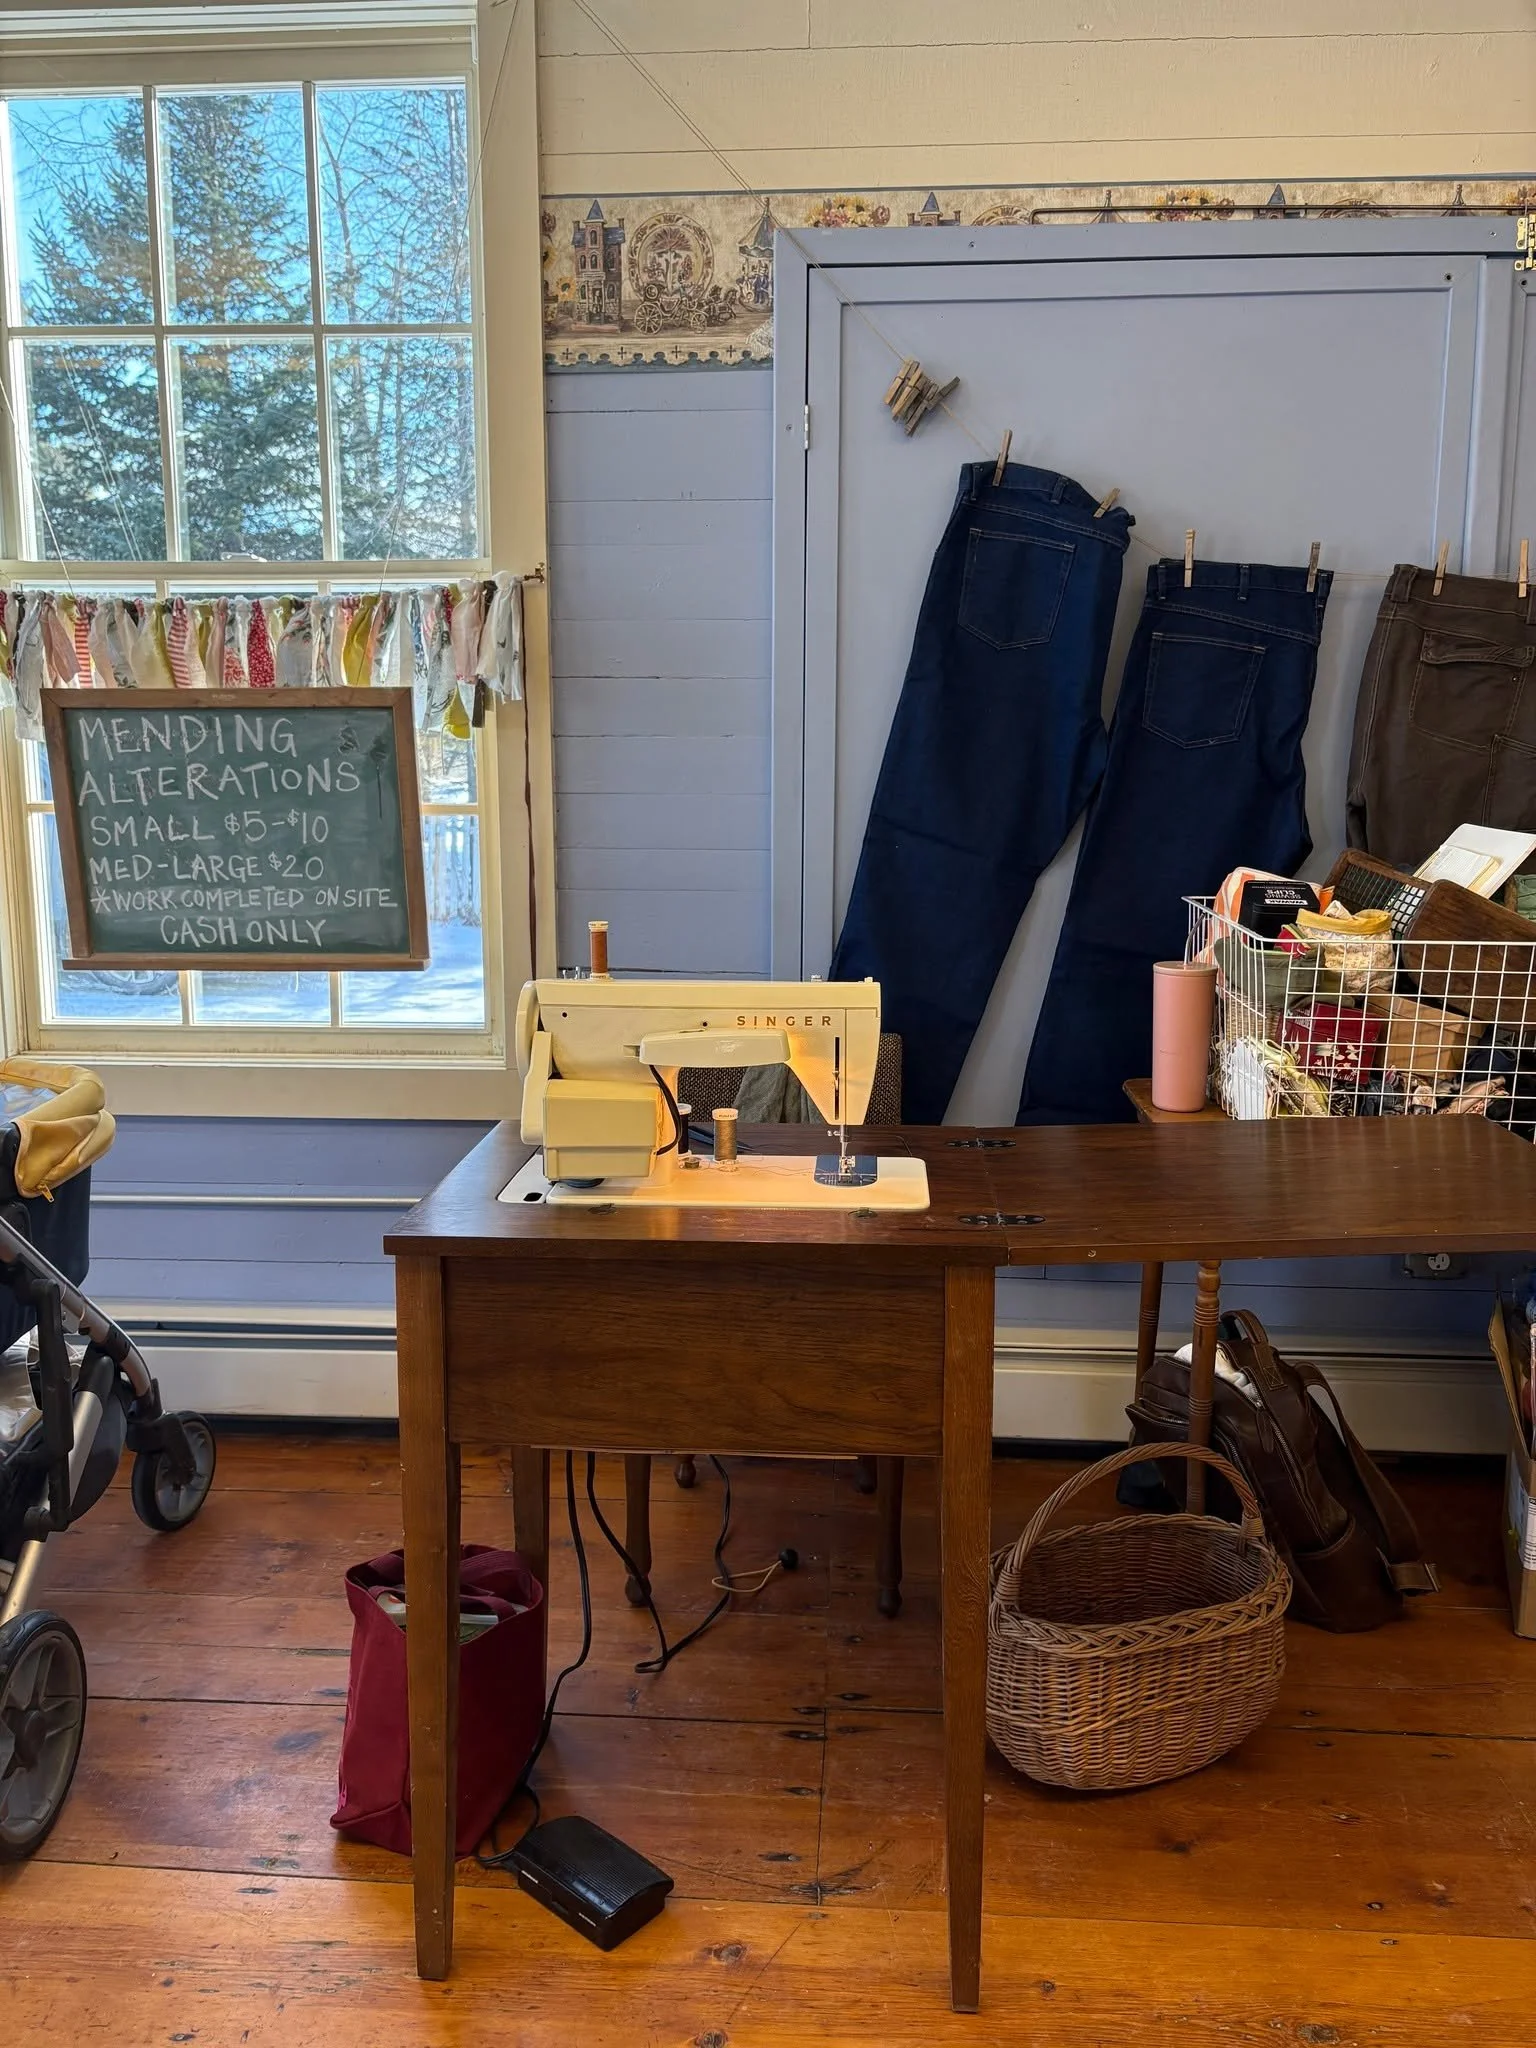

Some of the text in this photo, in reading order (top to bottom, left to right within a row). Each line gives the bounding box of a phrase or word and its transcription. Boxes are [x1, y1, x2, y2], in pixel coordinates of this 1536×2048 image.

[78, 714, 298, 761] MENDING
[78, 758, 361, 807] ALTERATIONS
[90, 815, 216, 847] SMALL
[90, 851, 324, 885] MED-LARGE $20
[181, 886, 304, 912] COMPLETED
[160, 915, 327, 948] CASH ONLY
[736, 1015, 832, 1027] SINGER
